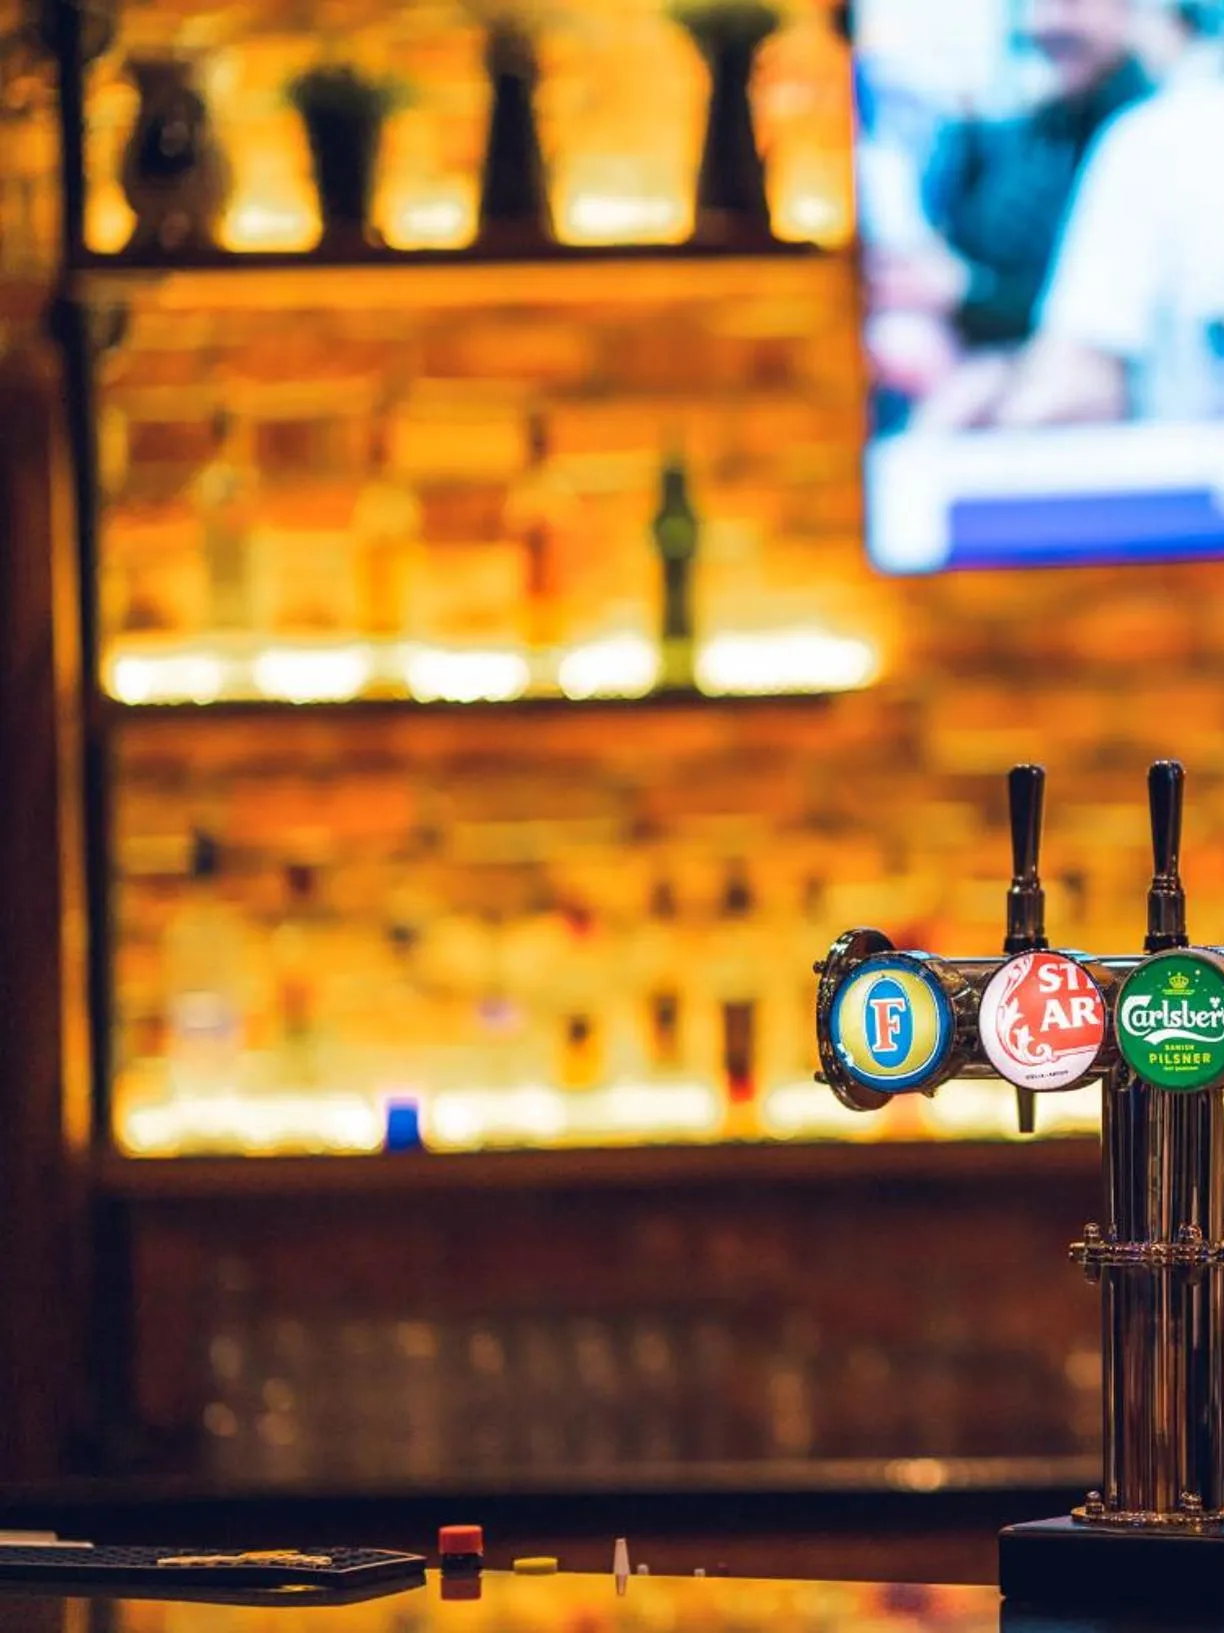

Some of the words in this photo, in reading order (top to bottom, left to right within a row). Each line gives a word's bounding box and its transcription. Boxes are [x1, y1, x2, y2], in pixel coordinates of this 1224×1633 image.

[1037, 962, 1096, 993] ST
[869, 997, 907, 1053] F
[1148, 1052, 1212, 1064] PILSNER
